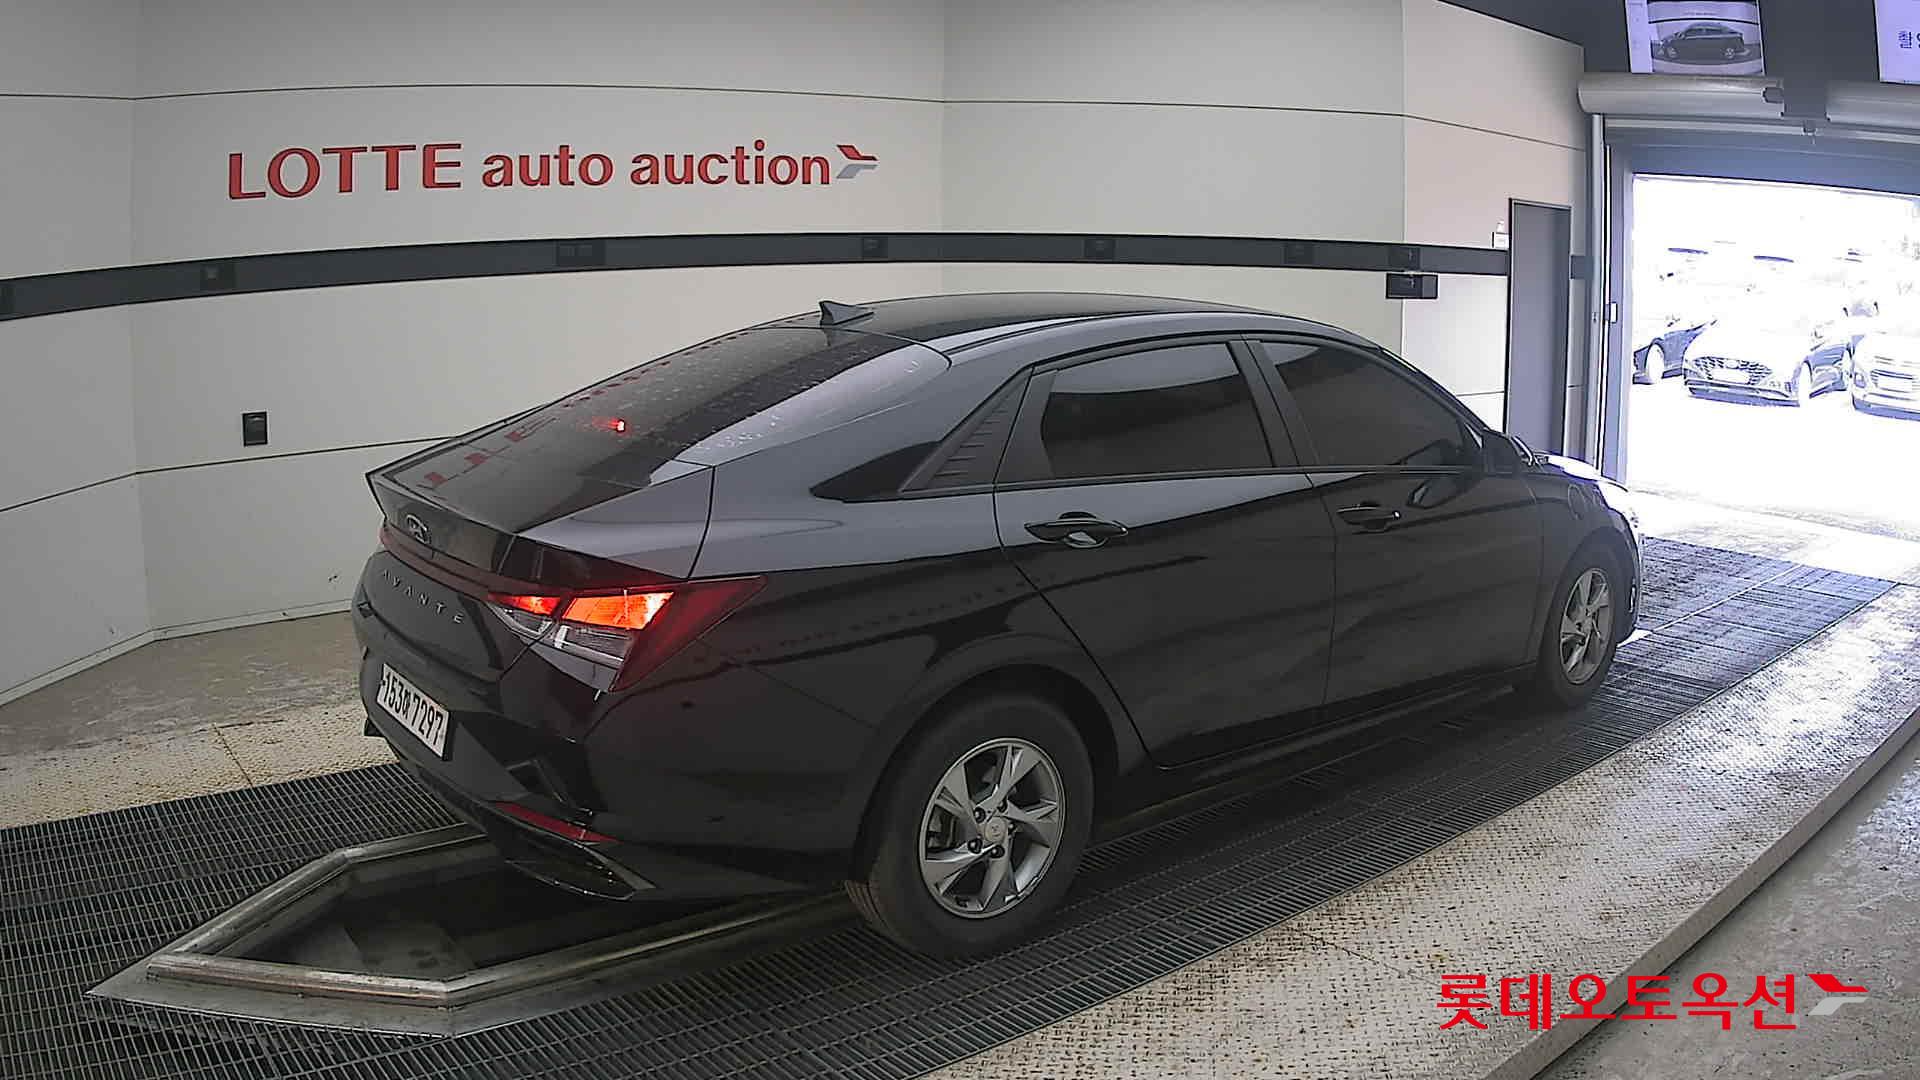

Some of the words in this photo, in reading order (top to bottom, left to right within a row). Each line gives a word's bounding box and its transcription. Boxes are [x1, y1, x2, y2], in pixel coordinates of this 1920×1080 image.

[228, 143, 462, 200] LOTTE
[481, 145, 614, 187] auto
[630, 139, 831, 186] auction
[382, 569, 465, 625] AVANTE
